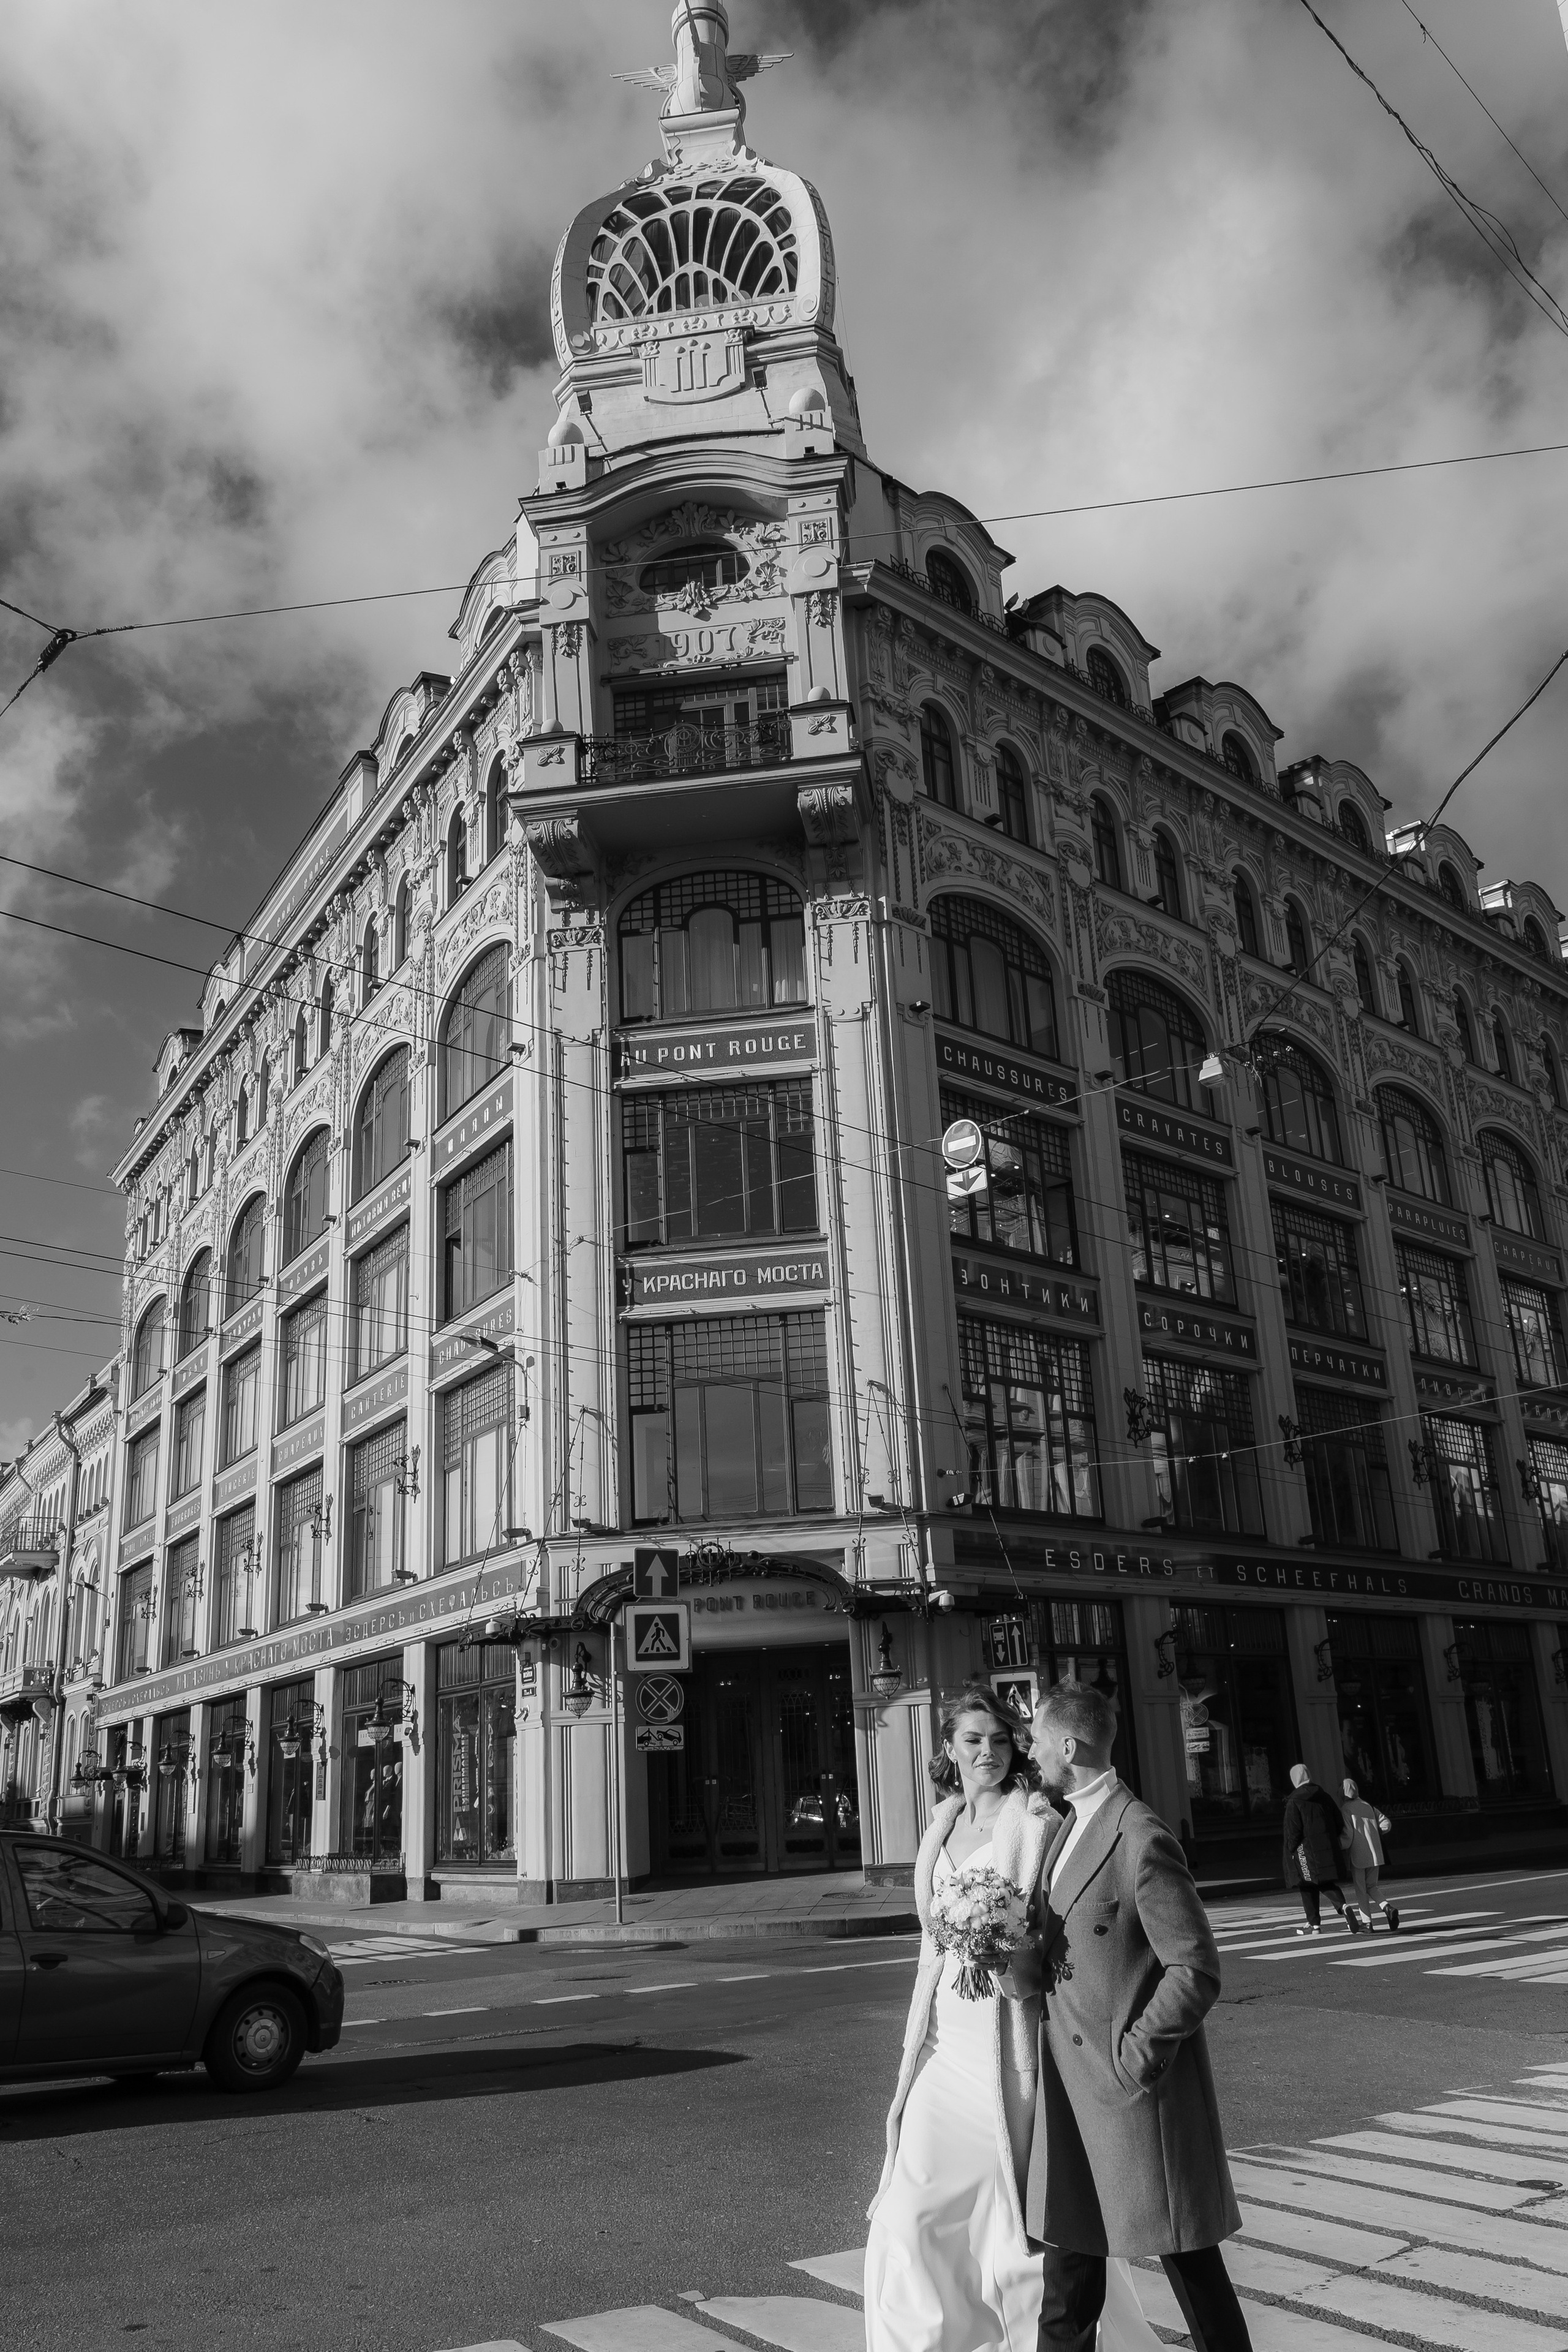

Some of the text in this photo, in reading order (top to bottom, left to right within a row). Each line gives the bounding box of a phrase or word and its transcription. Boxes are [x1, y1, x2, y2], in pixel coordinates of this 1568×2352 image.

[655, 626, 737, 662] 1907
[620, 1033, 807, 1067] AU PONT ROUGE
[944, 1046, 1068, 1101] CHAUSSURES
[447, 1095, 503, 1155] ШЛЯПЫ
[1123, 1108, 1223, 1155] CRAVATES
[1268, 1159, 1353, 1200] BLOUSES
[1494, 1241, 1559, 1274] CHAPEAUX
[622, 1262, 824, 1295] У КРАСНАГО МОСТА
[960, 1268, 1089, 1313] ЗОНТИКИ
[1144, 1312, 1248, 1349] СОРОЧКИ
[1291, 1346, 1381, 1380] ПЕРЧАТКИ
[1421, 1378, 1488, 1404] ЛИВРЕИ
[278, 1426, 323, 1463] CHAPEAUX
[1045, 1548, 1174, 1576] ESDERS
[1197, 1566, 1214, 1579] ET
[1236, 1564, 1408, 1594] SCHEEFHALS
[1458, 1580, 1532, 1604] GRANDS
[693, 1591, 822, 1614] PONT ROUGE
[176, 1663, 221, 1692] МАГАЗИНЪ
[225, 1660, 230, 1677] У
[234, 1642, 288, 1675] КРАСНАГО
[292, 1627, 333, 1657] МОСТА
[345, 1610, 405, 1642] ЭСДЕРСЪ
[419, 1576, 514, 1620] СХЕФАЛЬСЪ
[453, 1714, 462, 1813] PRISMA
